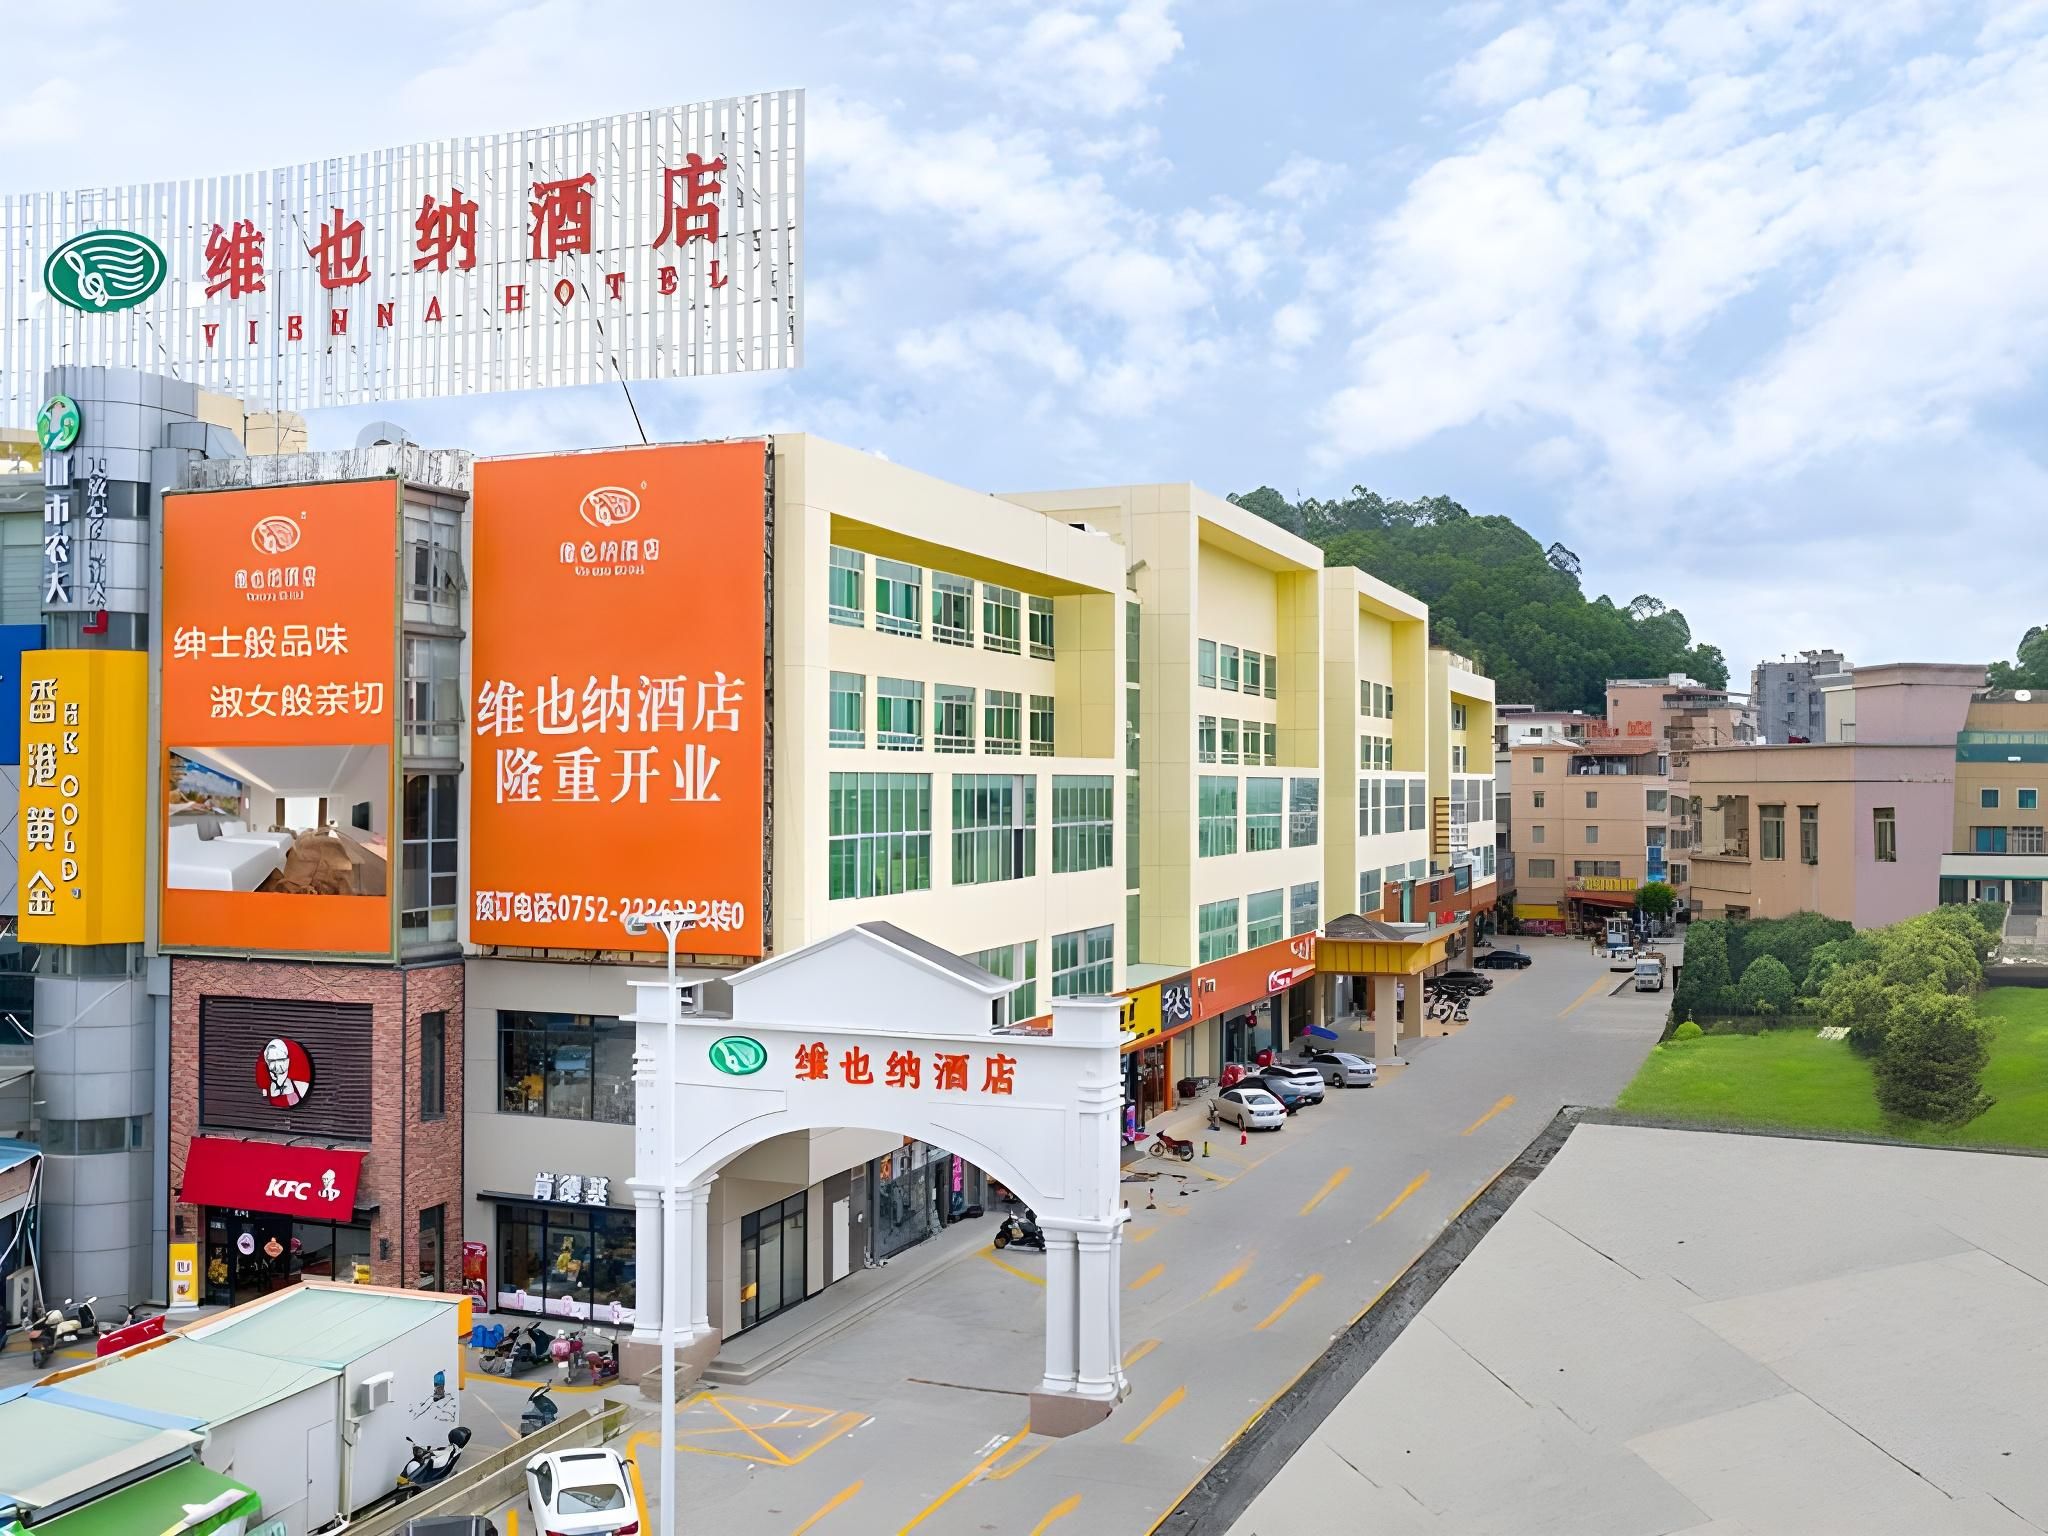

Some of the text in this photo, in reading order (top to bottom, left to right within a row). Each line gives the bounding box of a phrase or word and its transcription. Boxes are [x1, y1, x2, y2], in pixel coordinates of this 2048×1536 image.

[203, 152, 728, 299] 维也纳酒店
[504, 259, 729, 314] HOTEL
[173, 622, 349, 660] 绅士般品味
[210, 681, 385, 719] 淑女般亲切
[476, 671, 746, 738] 维也纳酒店
[495, 743, 722, 804] 隆重开业
[794, 1041, 1018, 1096] 维也纳酒店
[265, 1178, 312, 1201] KFC
